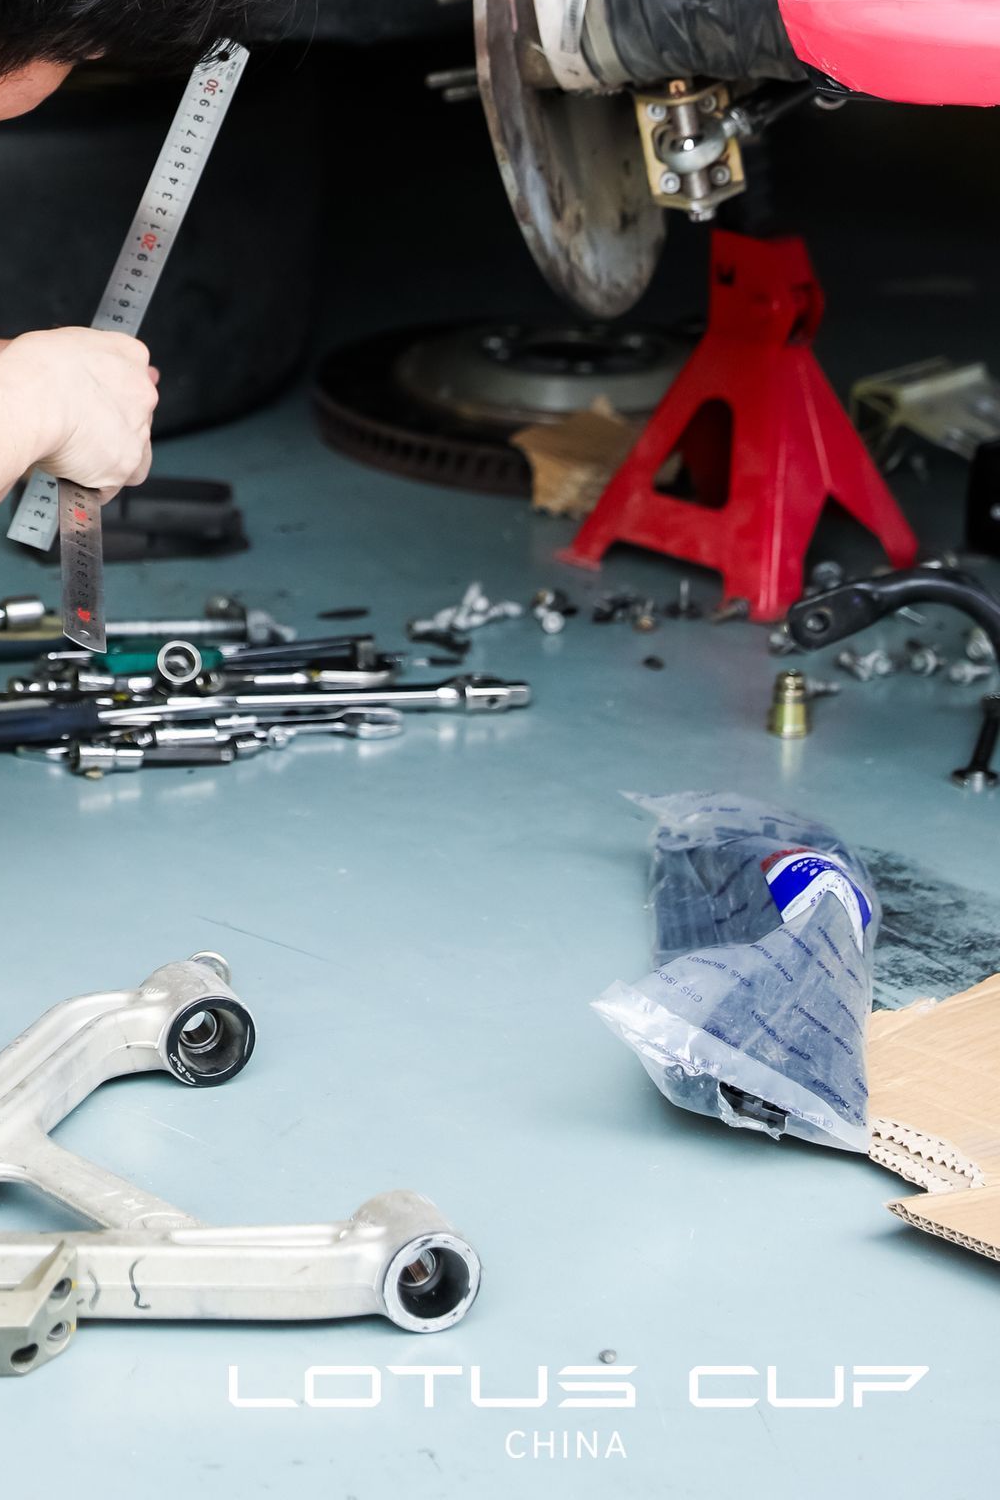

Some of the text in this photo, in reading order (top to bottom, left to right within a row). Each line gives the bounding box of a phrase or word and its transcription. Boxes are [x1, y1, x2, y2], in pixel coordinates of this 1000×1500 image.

[203, 79, 219, 96] 30
[199, 99, 211, 108] 9
[729, 969, 752, 988] CHS
[680, 986, 703, 1003] CHS
